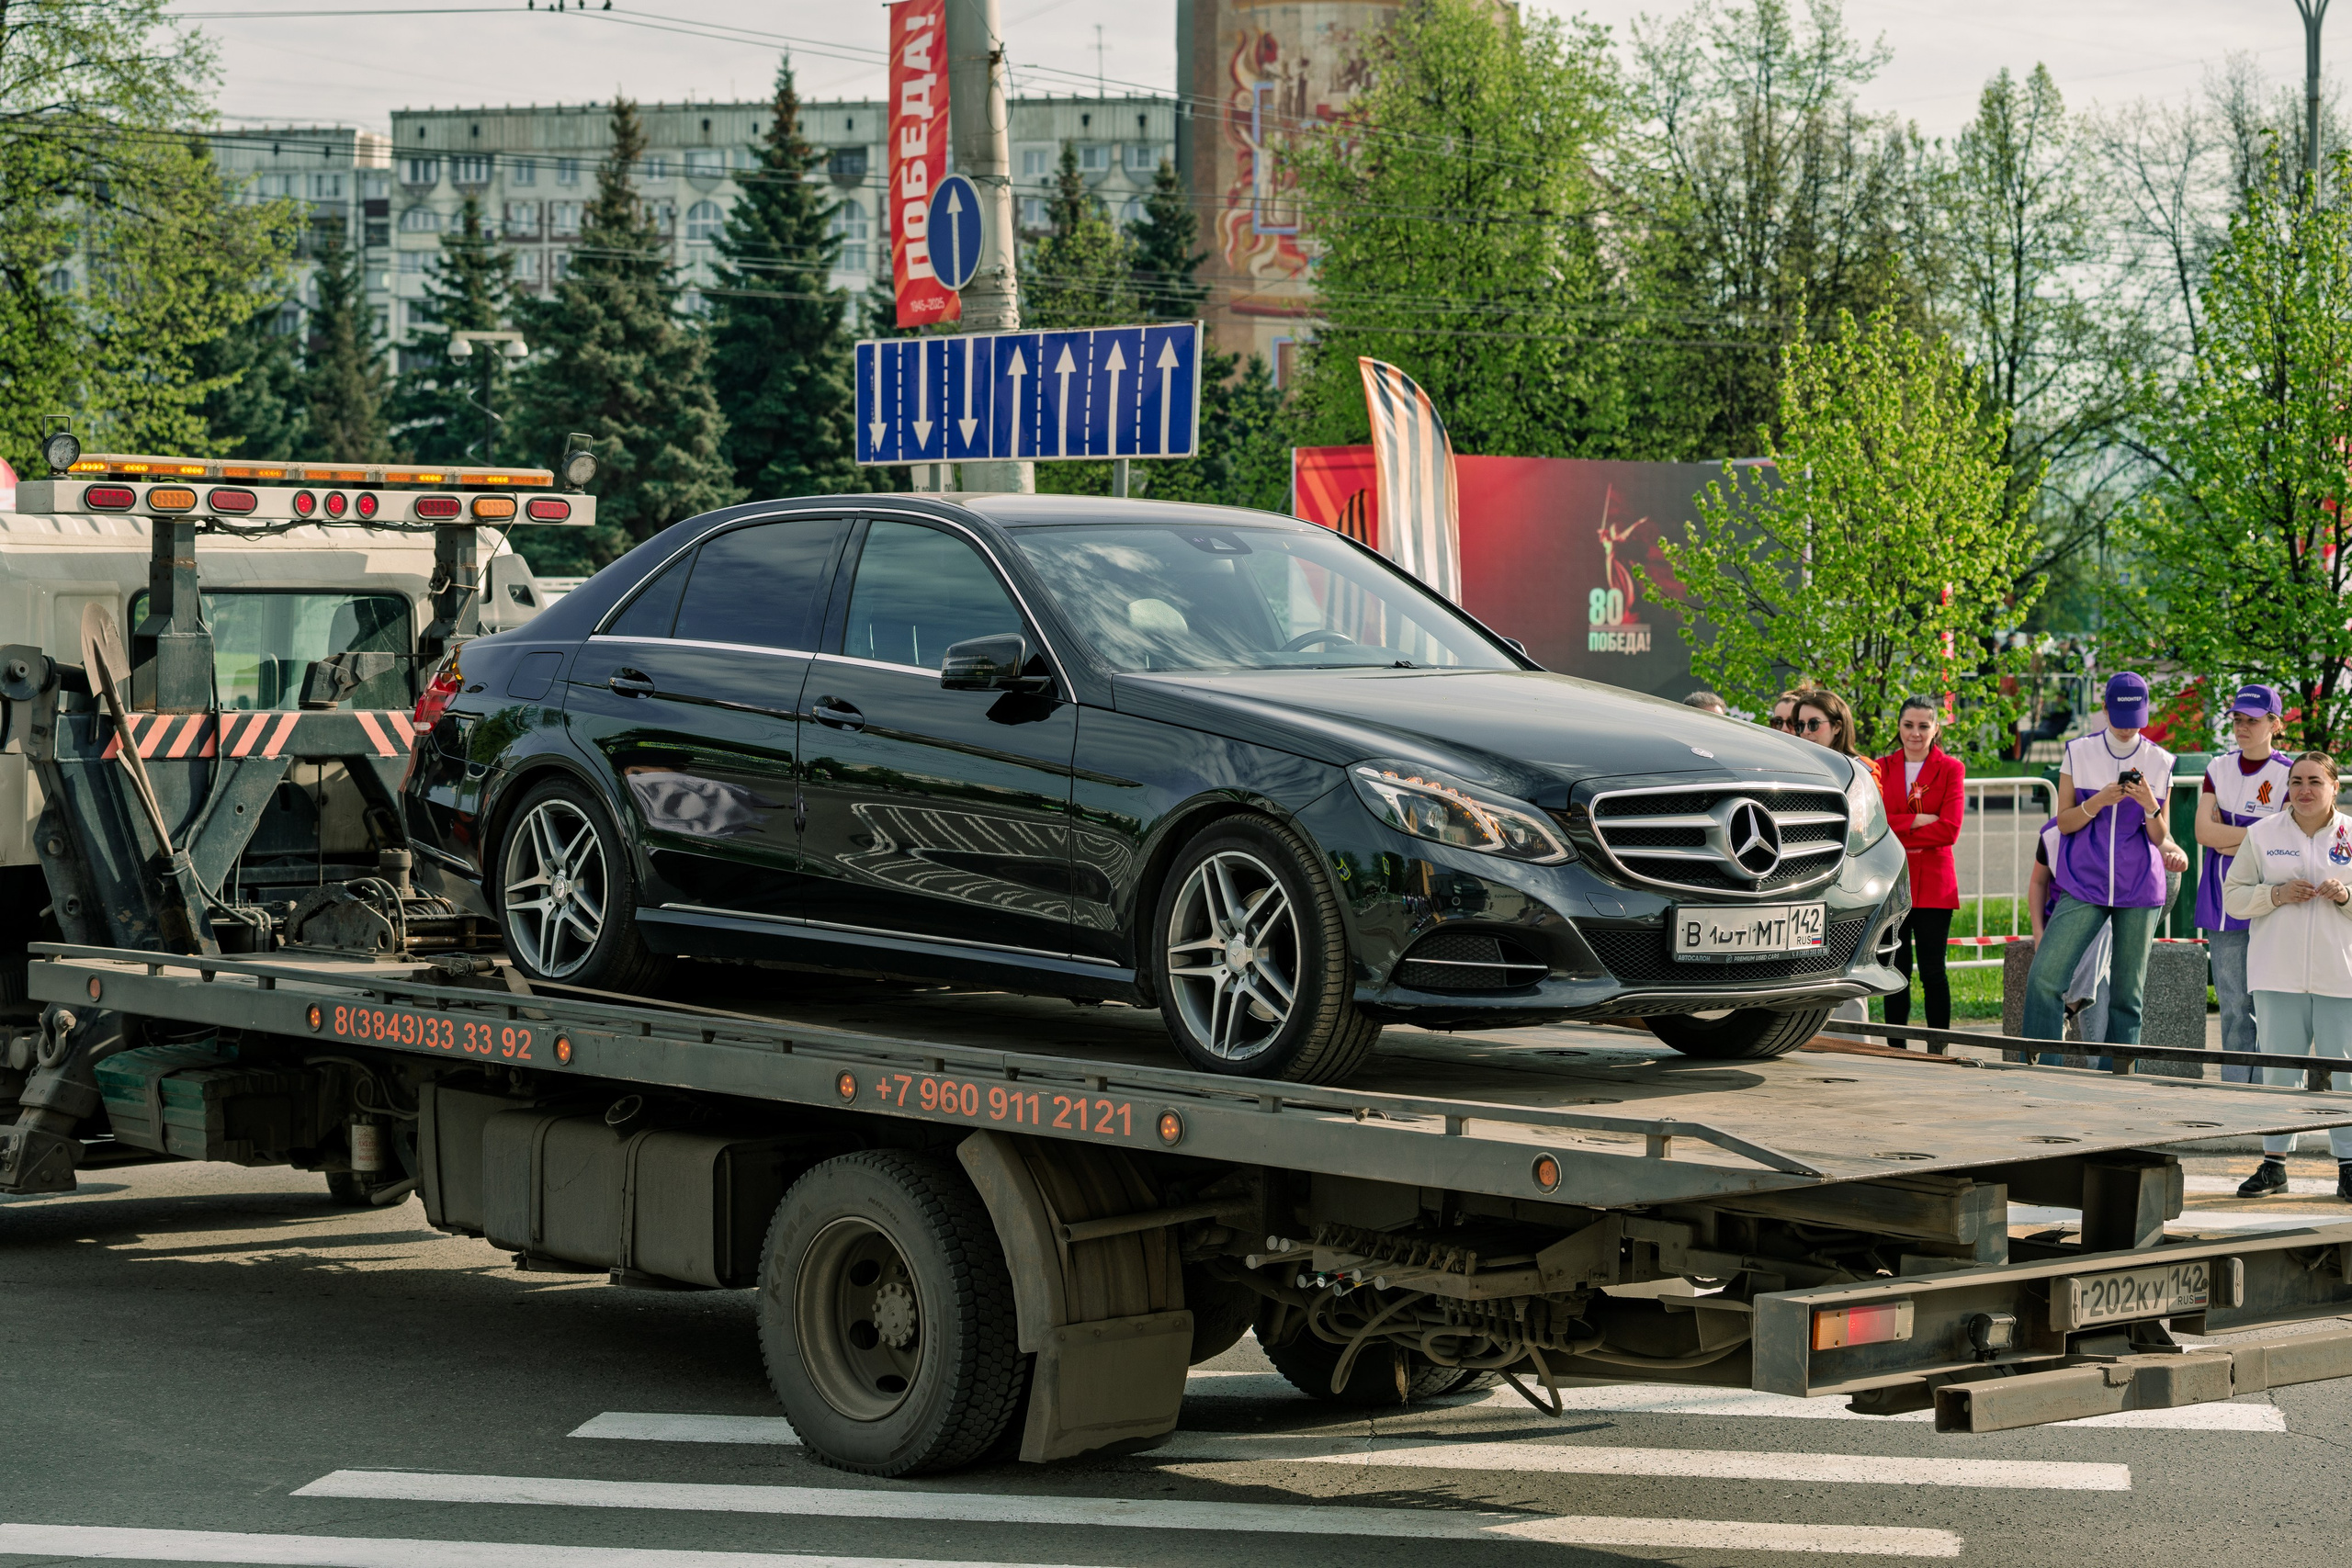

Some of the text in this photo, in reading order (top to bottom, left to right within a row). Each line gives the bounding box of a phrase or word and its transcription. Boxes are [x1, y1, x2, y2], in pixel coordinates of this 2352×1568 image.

[900, 14, 937, 281] ПОБЕДА!
[1589, 587, 1623, 626] 80
[1588, 631, 1651, 655] ПОБЕДА!
[1792, 908, 1820, 934] 142
[1796, 935, 1812, 945] RUS
[334, 1006, 532, 1060] 8(3843)33 33 92
[876, 1074, 1131, 1136] +7 960 911 2121
[2170, 1265, 2203, 1294] 142
[2177, 1294, 2194, 1306] RUS
